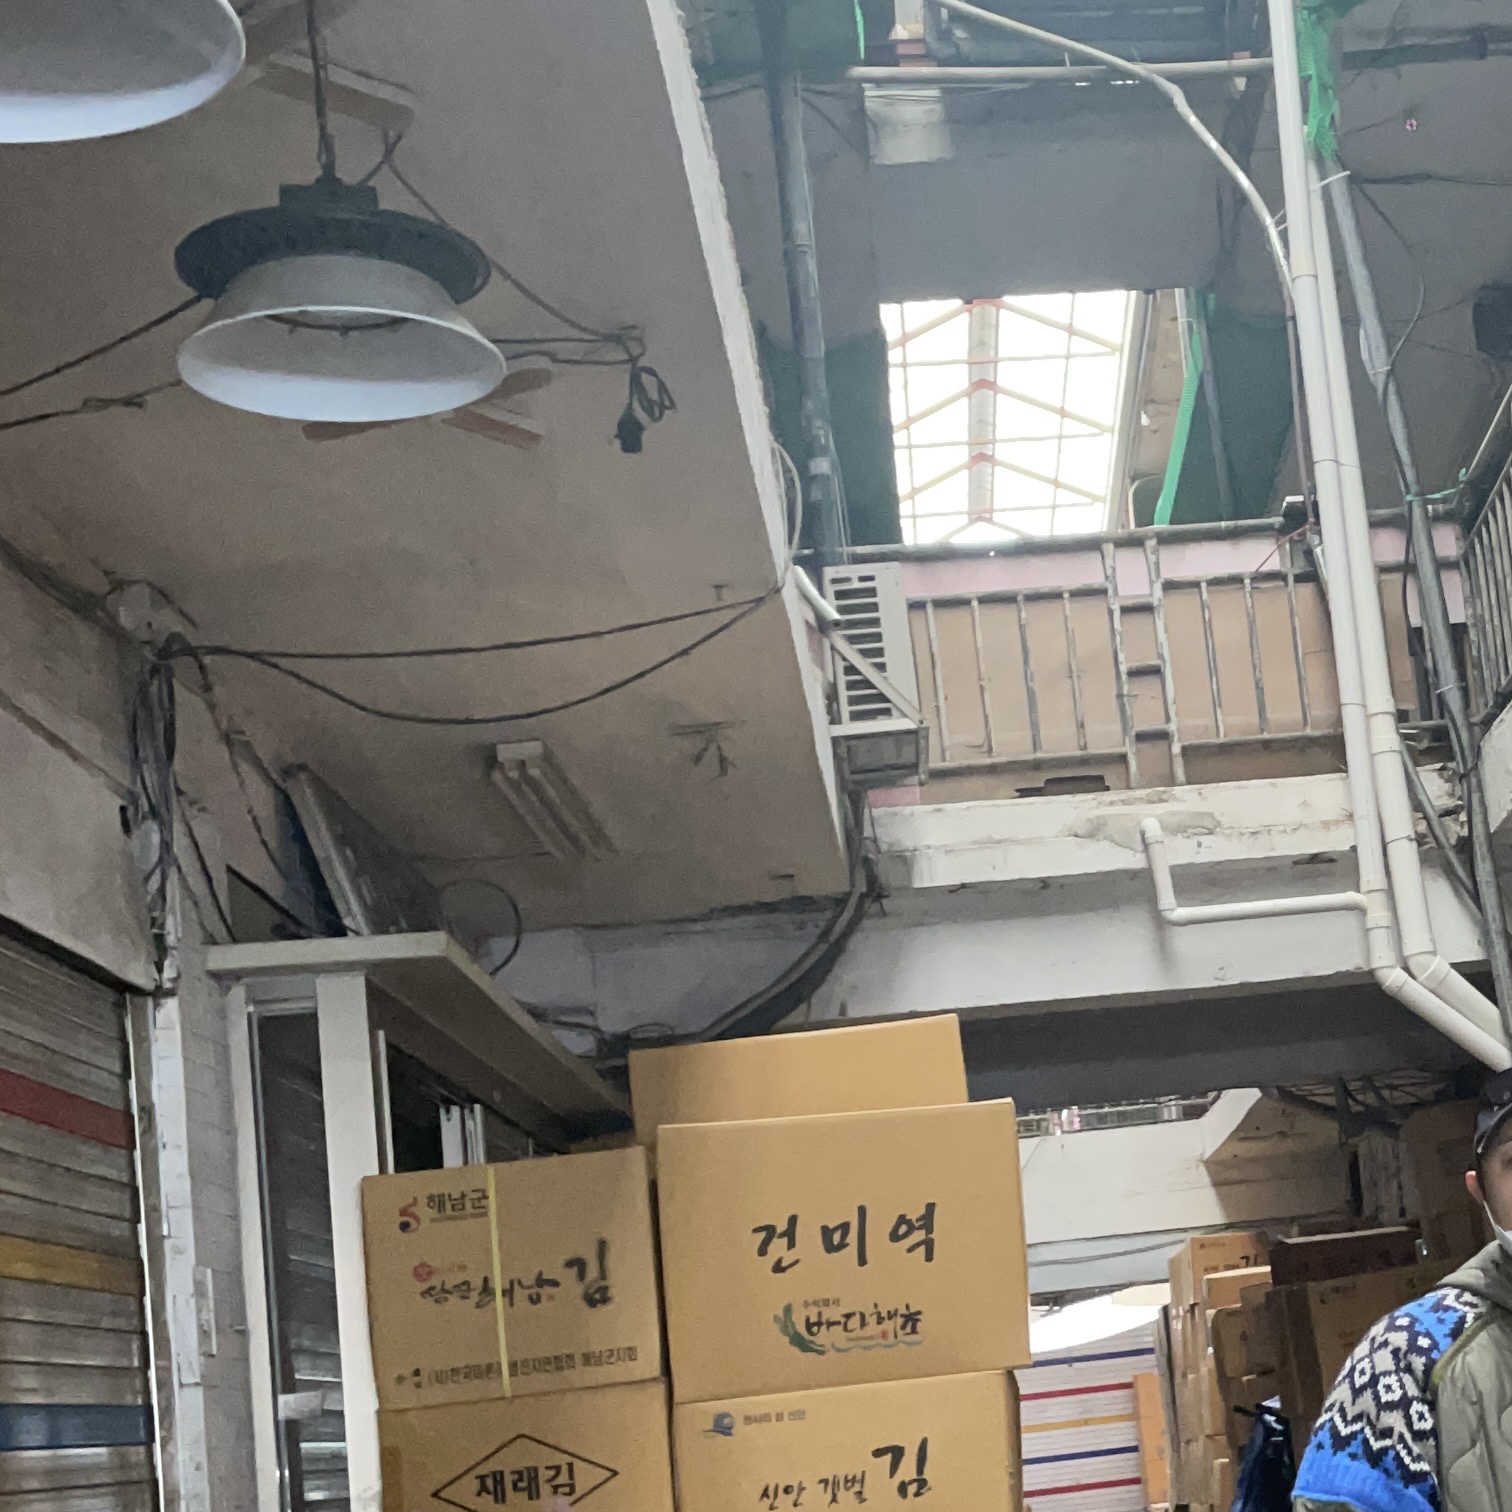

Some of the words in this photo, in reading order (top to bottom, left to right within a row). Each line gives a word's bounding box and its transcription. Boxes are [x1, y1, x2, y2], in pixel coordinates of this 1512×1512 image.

[425, 1188, 489, 1214] 해남군
[564, 1237, 614, 1310] 김
[751, 1201, 937, 1275] 건미역
[474, 1461, 577, 1505] 재래김
[757, 1480, 807, 1512] 신안
[816, 1469, 869, 1509] 갯벌
[870, 1435, 933, 1500] 김
